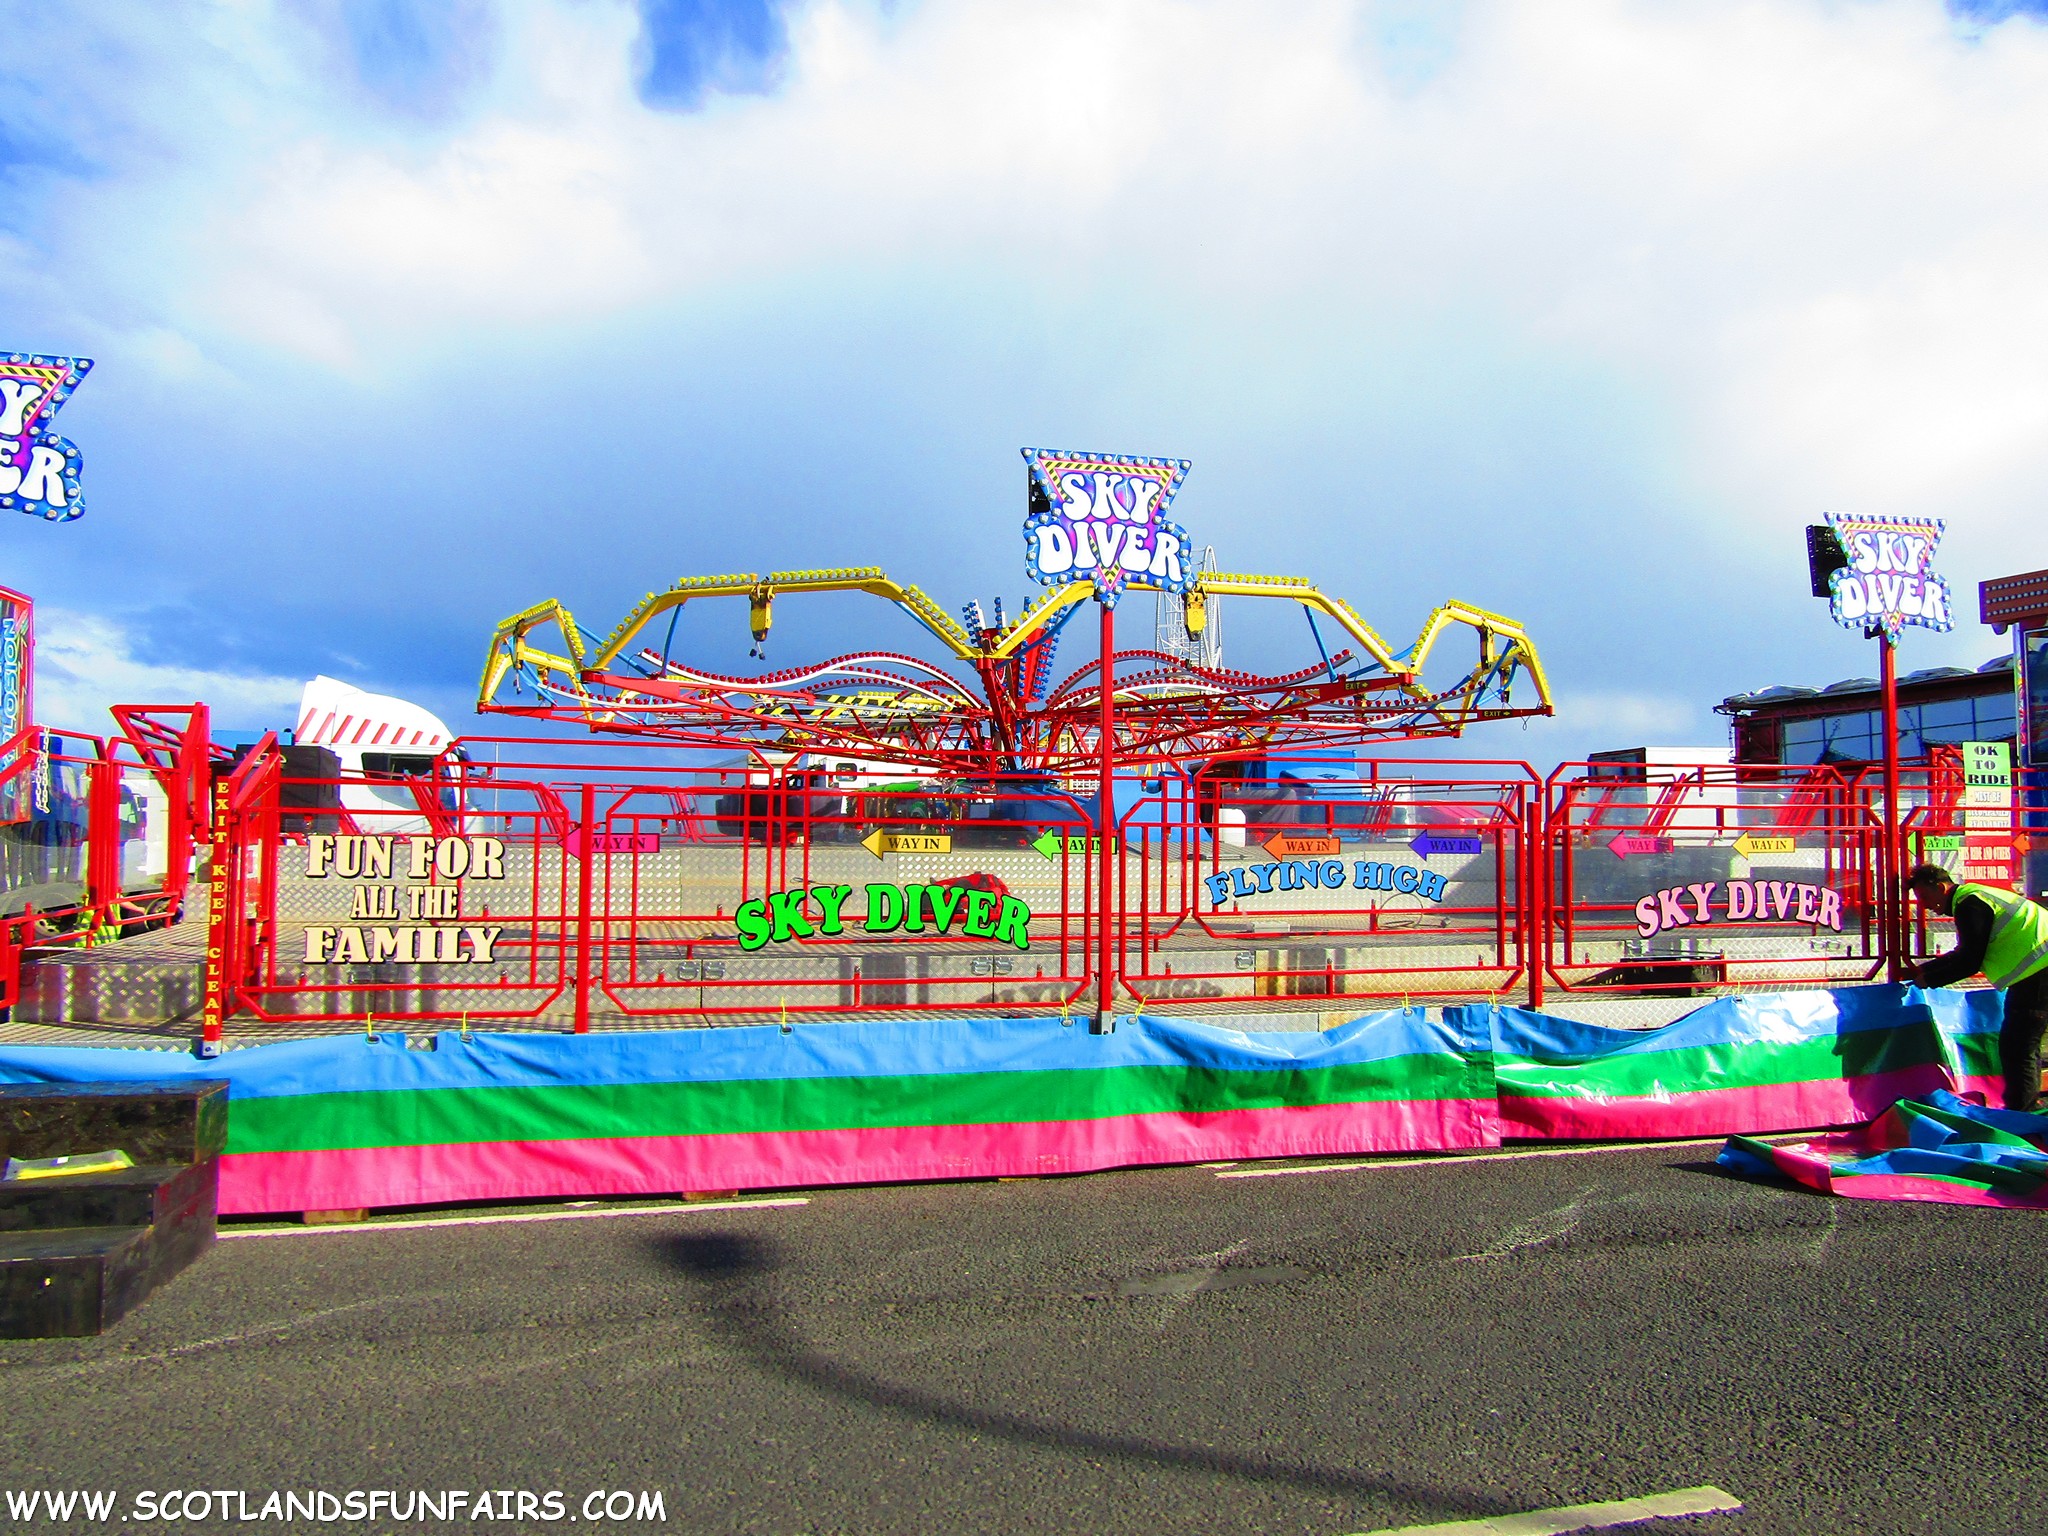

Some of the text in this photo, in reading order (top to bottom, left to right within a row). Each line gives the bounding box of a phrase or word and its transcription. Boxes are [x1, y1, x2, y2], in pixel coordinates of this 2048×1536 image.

[1061, 472, 1160, 524] SKY
[1035, 521, 1183, 582] DIVER
[1854, 531, 1926, 575] SKY
[1838, 573, 1947, 623] DIVER
[3, 618, 17, 798] ELOSION
[1973, 760, 1996, 770] TO
[1974, 746, 1999, 756] OK
[1968, 774, 2009, 785] RIDE
[305, 835, 505, 879] FUN FOR
[888, 838, 941, 849] WAY IN
[1286, 841, 1330, 852] WAY IN
[1430, 840, 1472, 851] WAY IN
[1627, 840, 1651, 851] WAY
[1751, 840, 1787, 850] WAY IN
[1942, 838, 1954, 848] IN
[350, 884, 458, 920] ALL THE
[1204, 860, 1449, 905] FLYING HIGH
[205, 782, 229, 1026] EXIT KEEP CLEAR
[735, 883, 1031, 951] SKY DIVER
[1635, 880, 1843, 939] SKY DIVER
[302, 926, 502, 965] FAMILY
